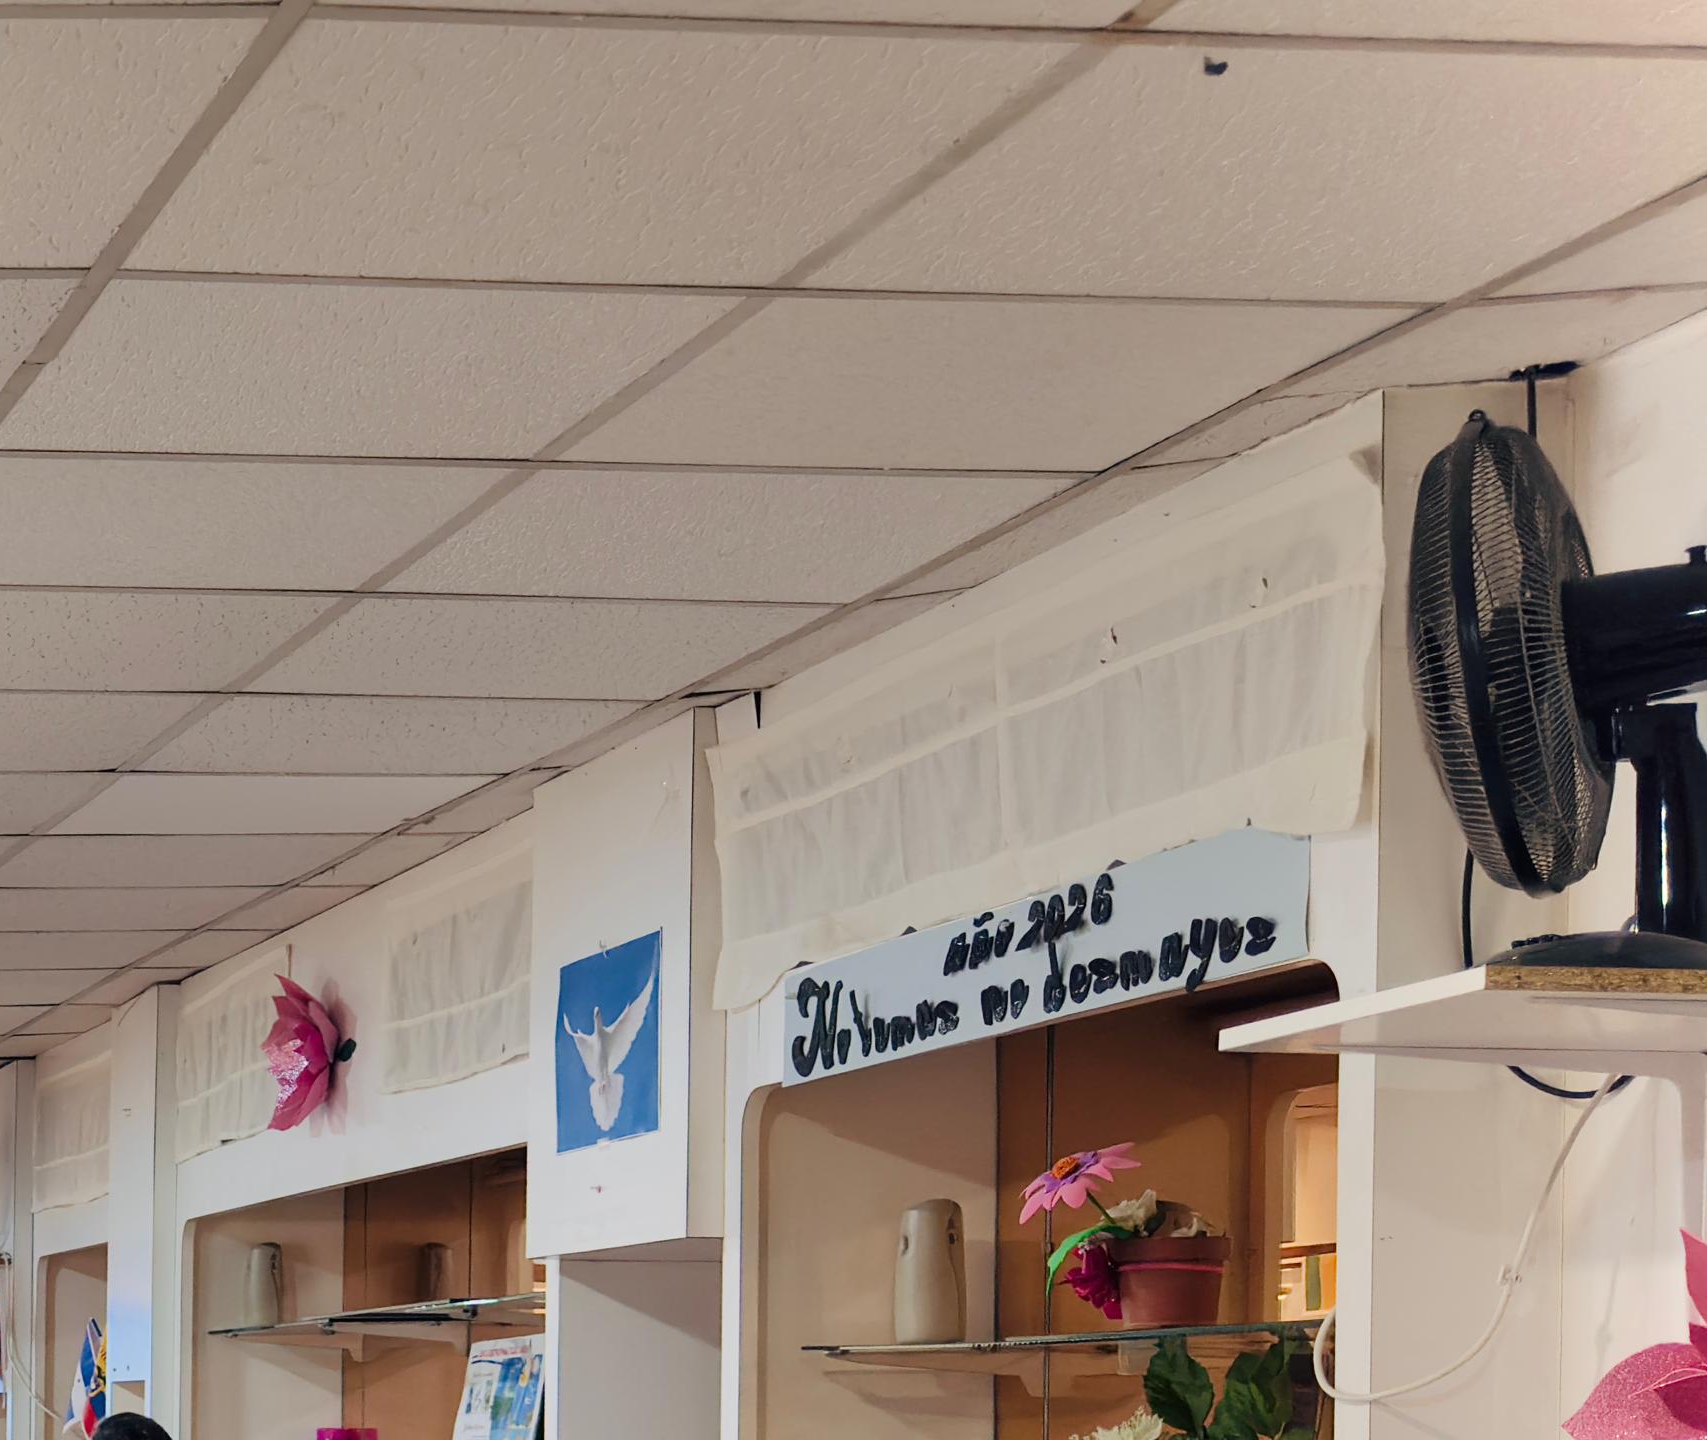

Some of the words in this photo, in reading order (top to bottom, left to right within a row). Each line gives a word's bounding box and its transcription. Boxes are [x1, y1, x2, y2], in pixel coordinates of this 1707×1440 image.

[1015, 872, 1115, 953] 2026
[791, 977, 853, 1077] No
[849, 989, 961, 1058] temas
[980, 978, 1030, 1026] no
[1043, 916, 1277, 1014] desmayes
